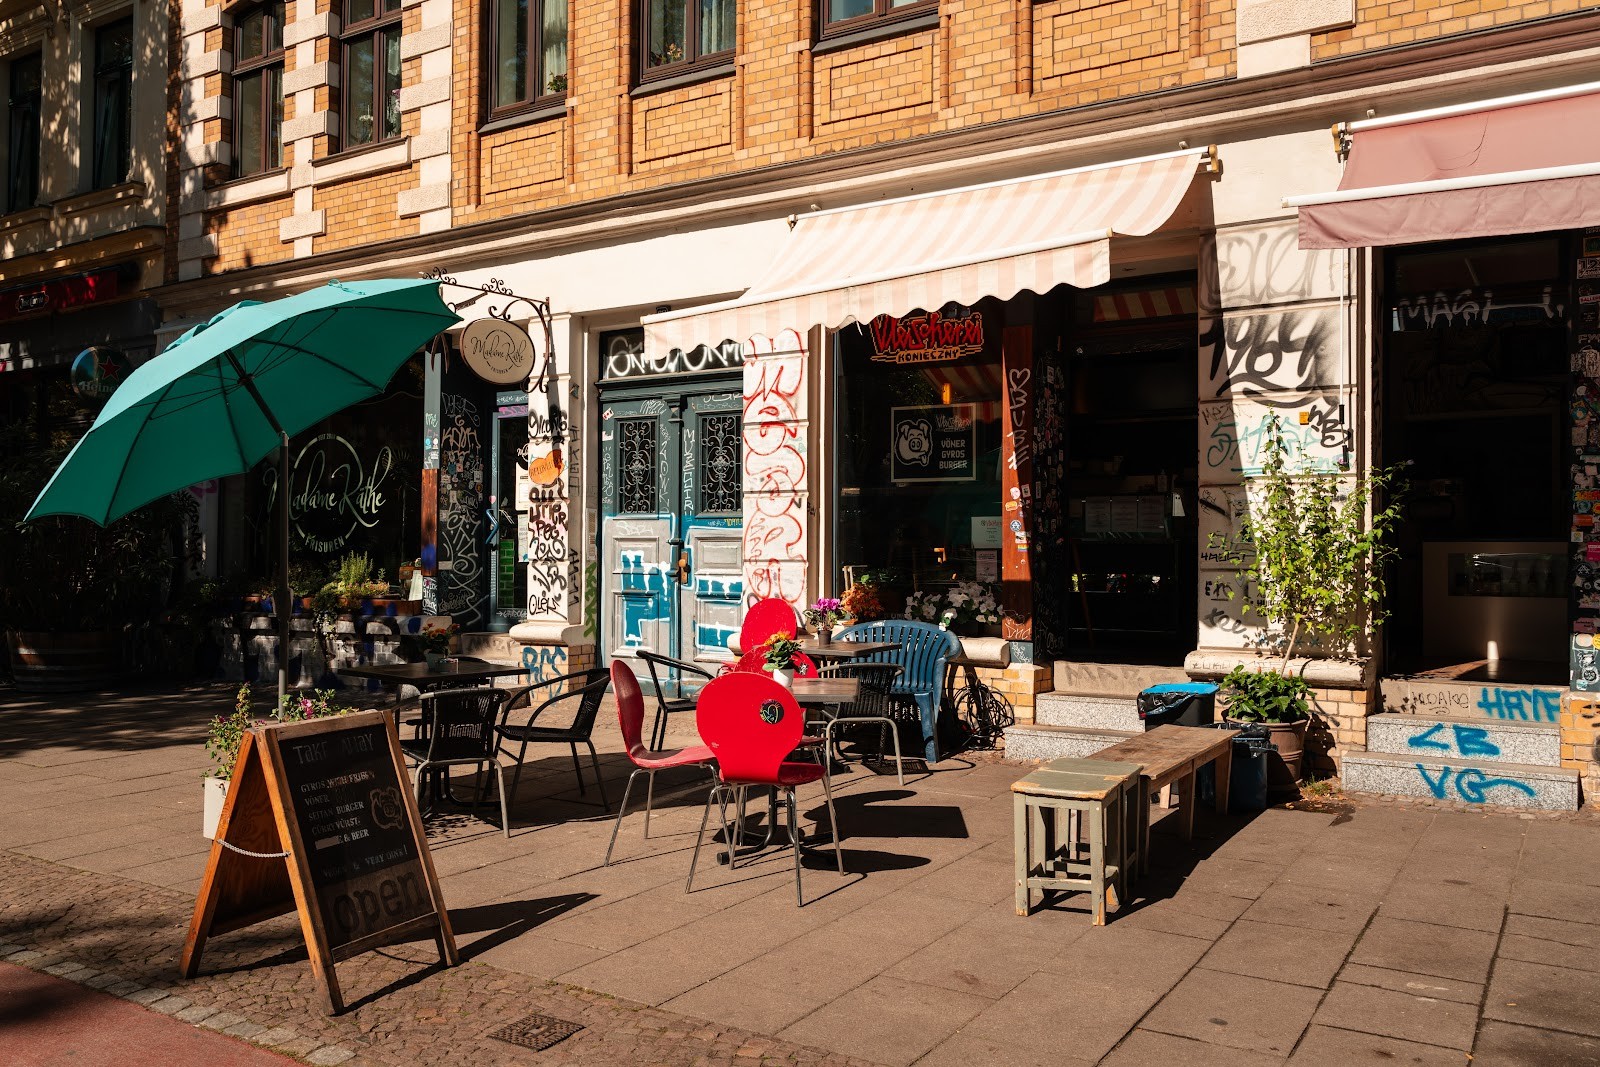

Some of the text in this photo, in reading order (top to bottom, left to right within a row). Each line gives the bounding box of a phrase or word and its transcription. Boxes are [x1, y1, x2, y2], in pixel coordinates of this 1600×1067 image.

[898, 350, 959, 362] KONIECZNY
[78, 380, 118, 394] Heine
[941, 438, 966, 449] VÖNER
[941, 450, 966, 459] GYROS
[938, 460, 968, 470] BURGER
[305, 535, 346, 553] FRISUREN
[335, 801, 365, 815] BURGER
[351, 828, 370, 841] BEER
